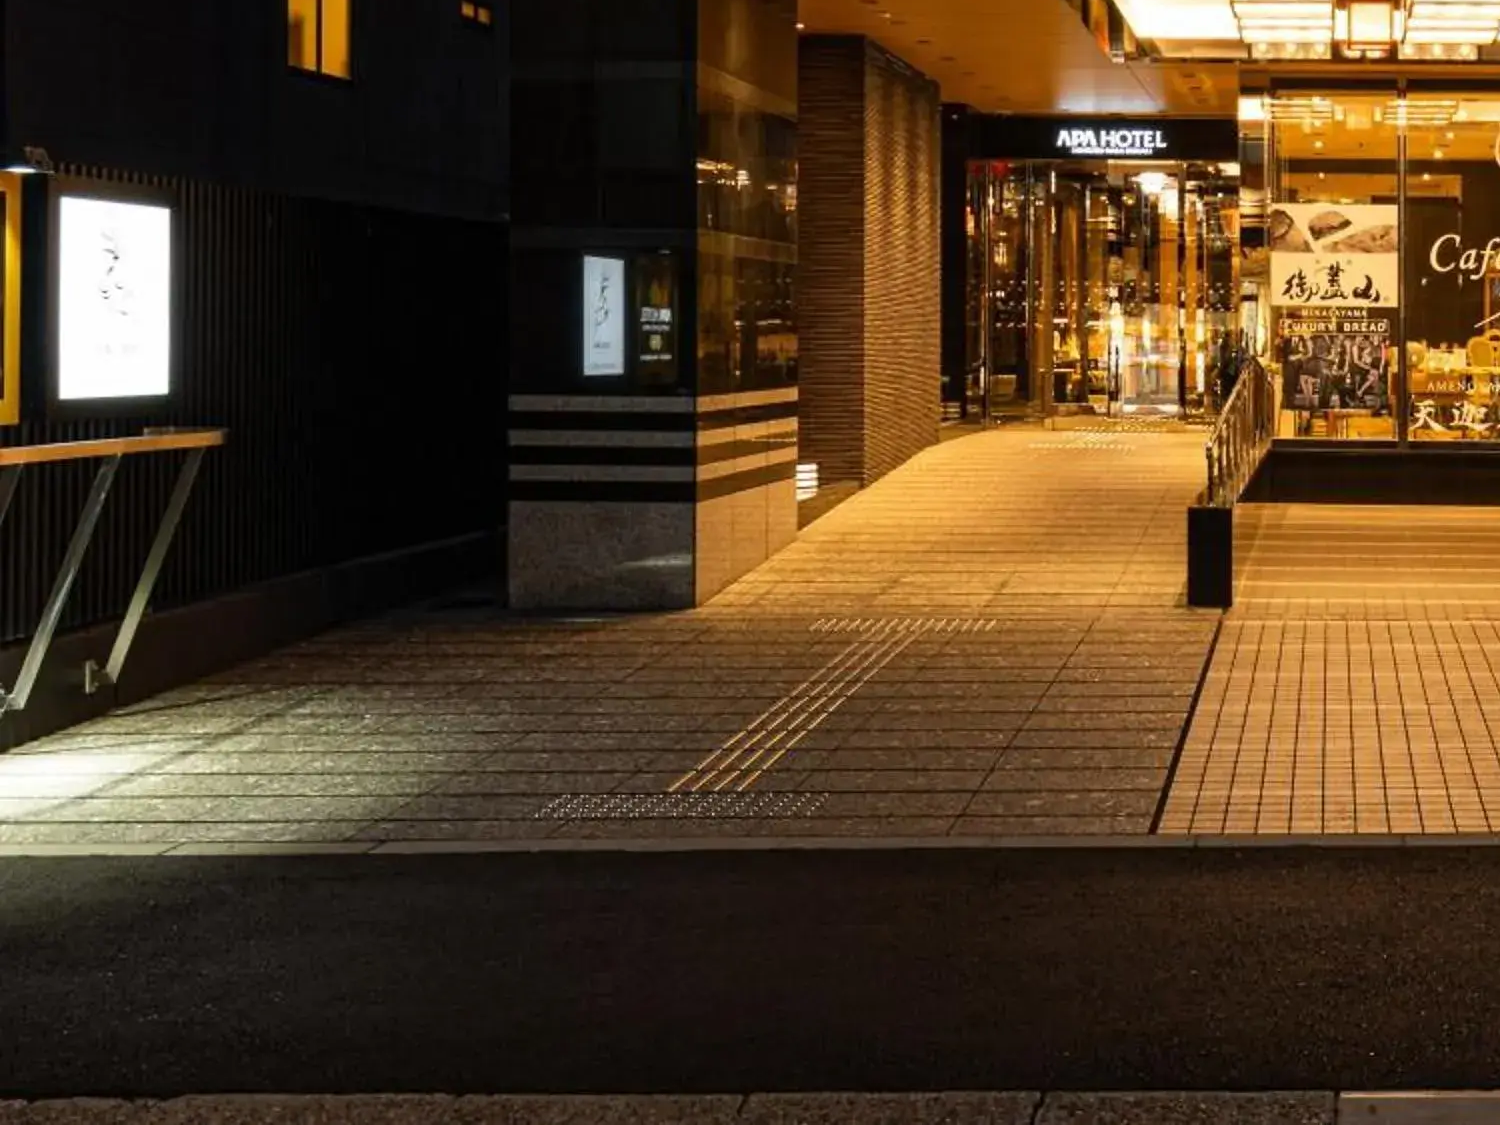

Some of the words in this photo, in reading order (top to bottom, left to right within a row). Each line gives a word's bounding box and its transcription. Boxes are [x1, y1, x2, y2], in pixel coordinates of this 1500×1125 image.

[1056, 129, 1098, 147] APA
[1099, 129, 1168, 148] HOTEL
[1343, 321, 1386, 332] BREAD
